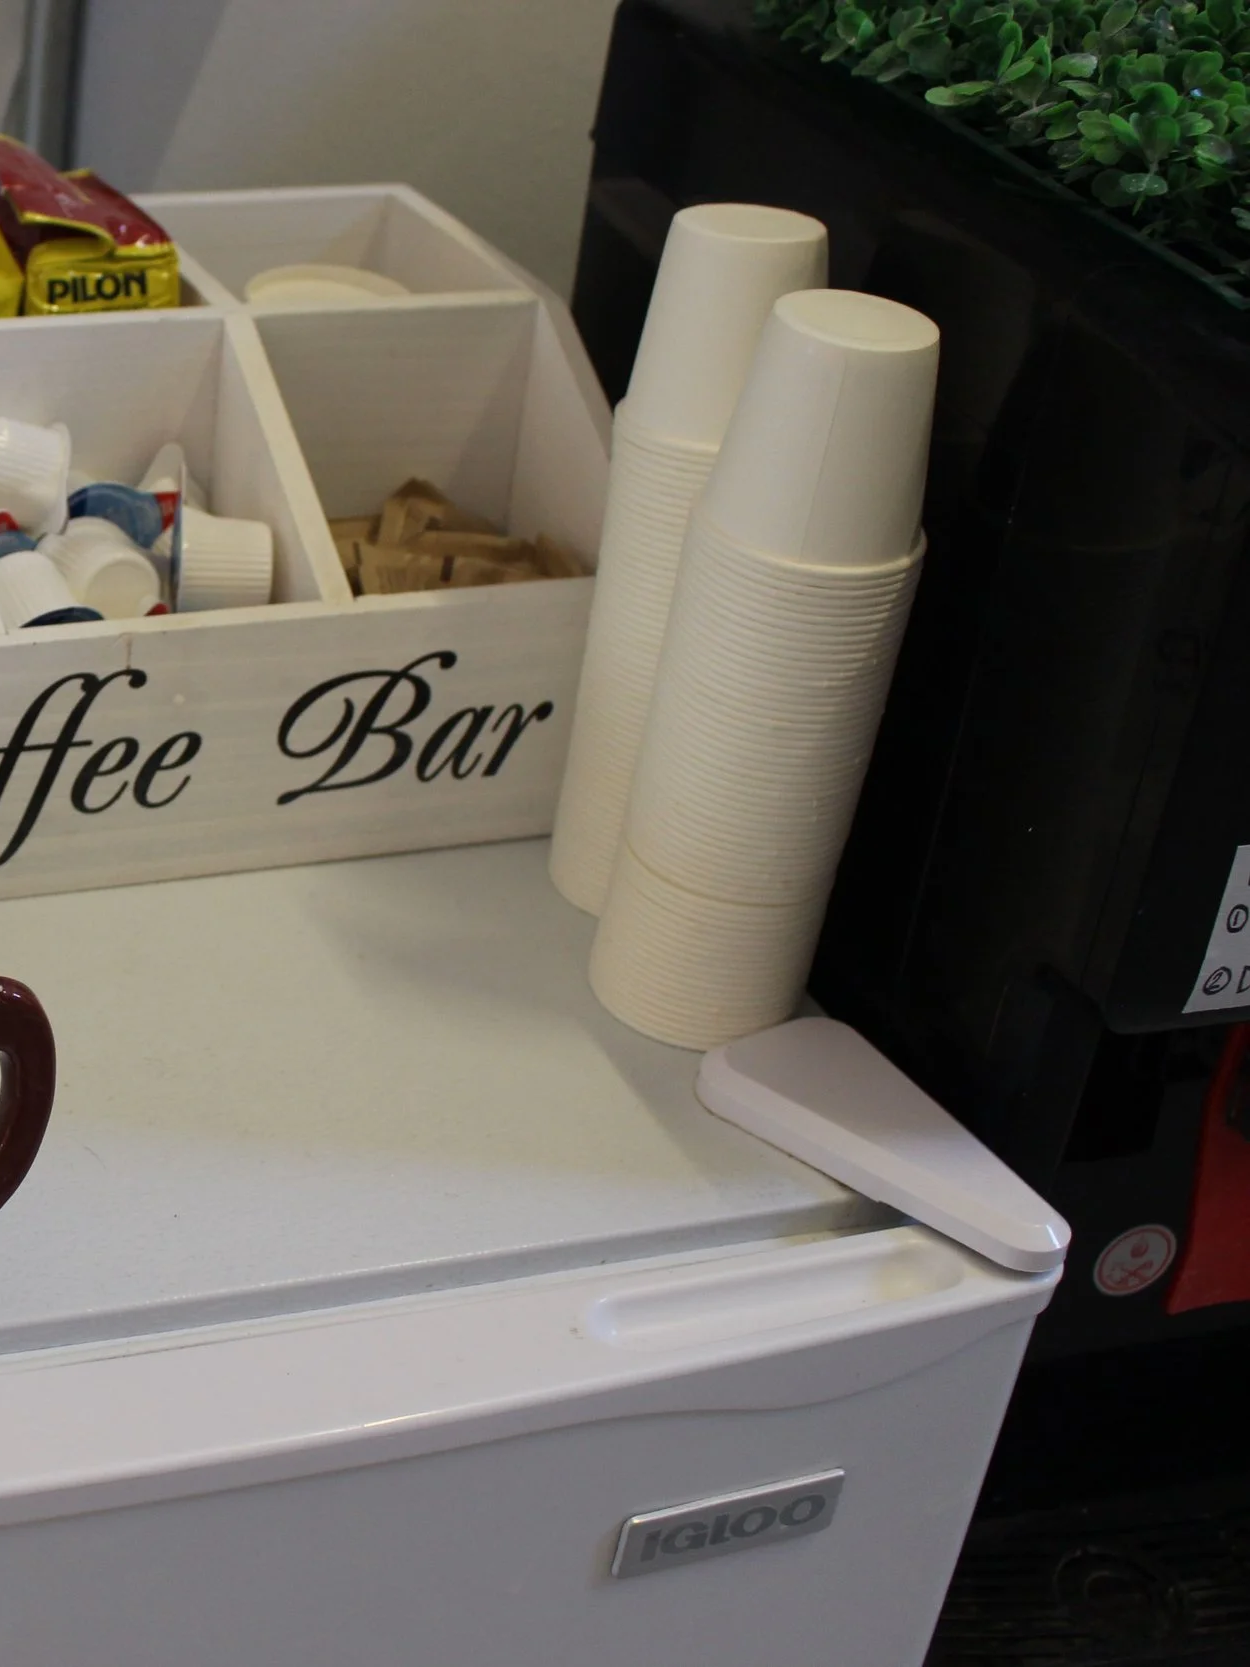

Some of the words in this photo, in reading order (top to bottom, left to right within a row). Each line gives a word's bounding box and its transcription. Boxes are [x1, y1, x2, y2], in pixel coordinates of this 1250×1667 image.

[46, 269, 148, 305] PILON
[276, 650, 554, 806] Bar
[640, 1493, 826, 1562] IGLOO
